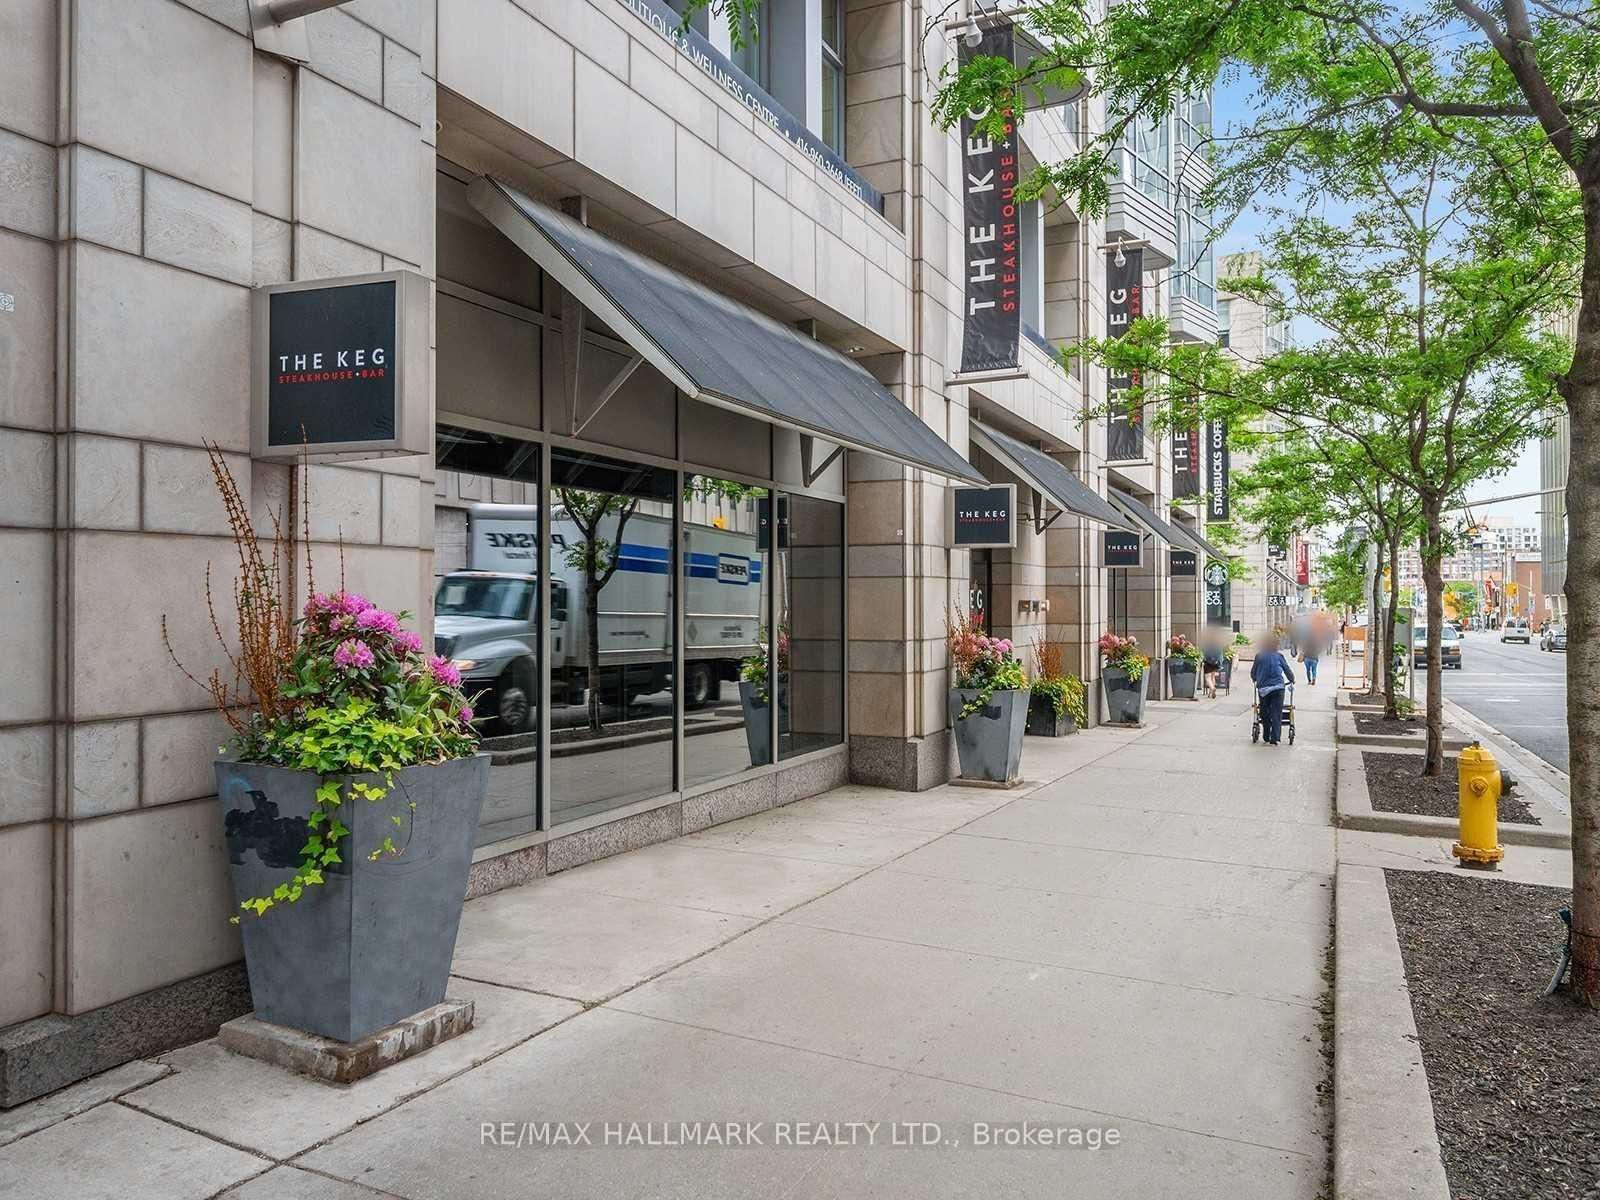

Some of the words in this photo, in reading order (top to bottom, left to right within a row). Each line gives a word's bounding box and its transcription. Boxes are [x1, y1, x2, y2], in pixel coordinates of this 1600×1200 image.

[627, 0, 678, 42] UTIQUE
[681, 38, 692, 54] &
[692, 46, 743, 101] WELLNESS
[745, 93, 779, 128] CENTRE
[1000, 155, 1015, 312] STEAKHOUSE
[969, 222, 996, 316] THE
[279, 353, 322, 372] THE
[337, 347, 385, 368] KEG
[279, 370, 353, 384] STEAKHOUSE
[361, 368, 385, 378] BAR
[1174, 432, 1188, 474] THE
[1213, 451, 1223, 515] STARBUCKS
[984, 510, 1006, 518] KEG
